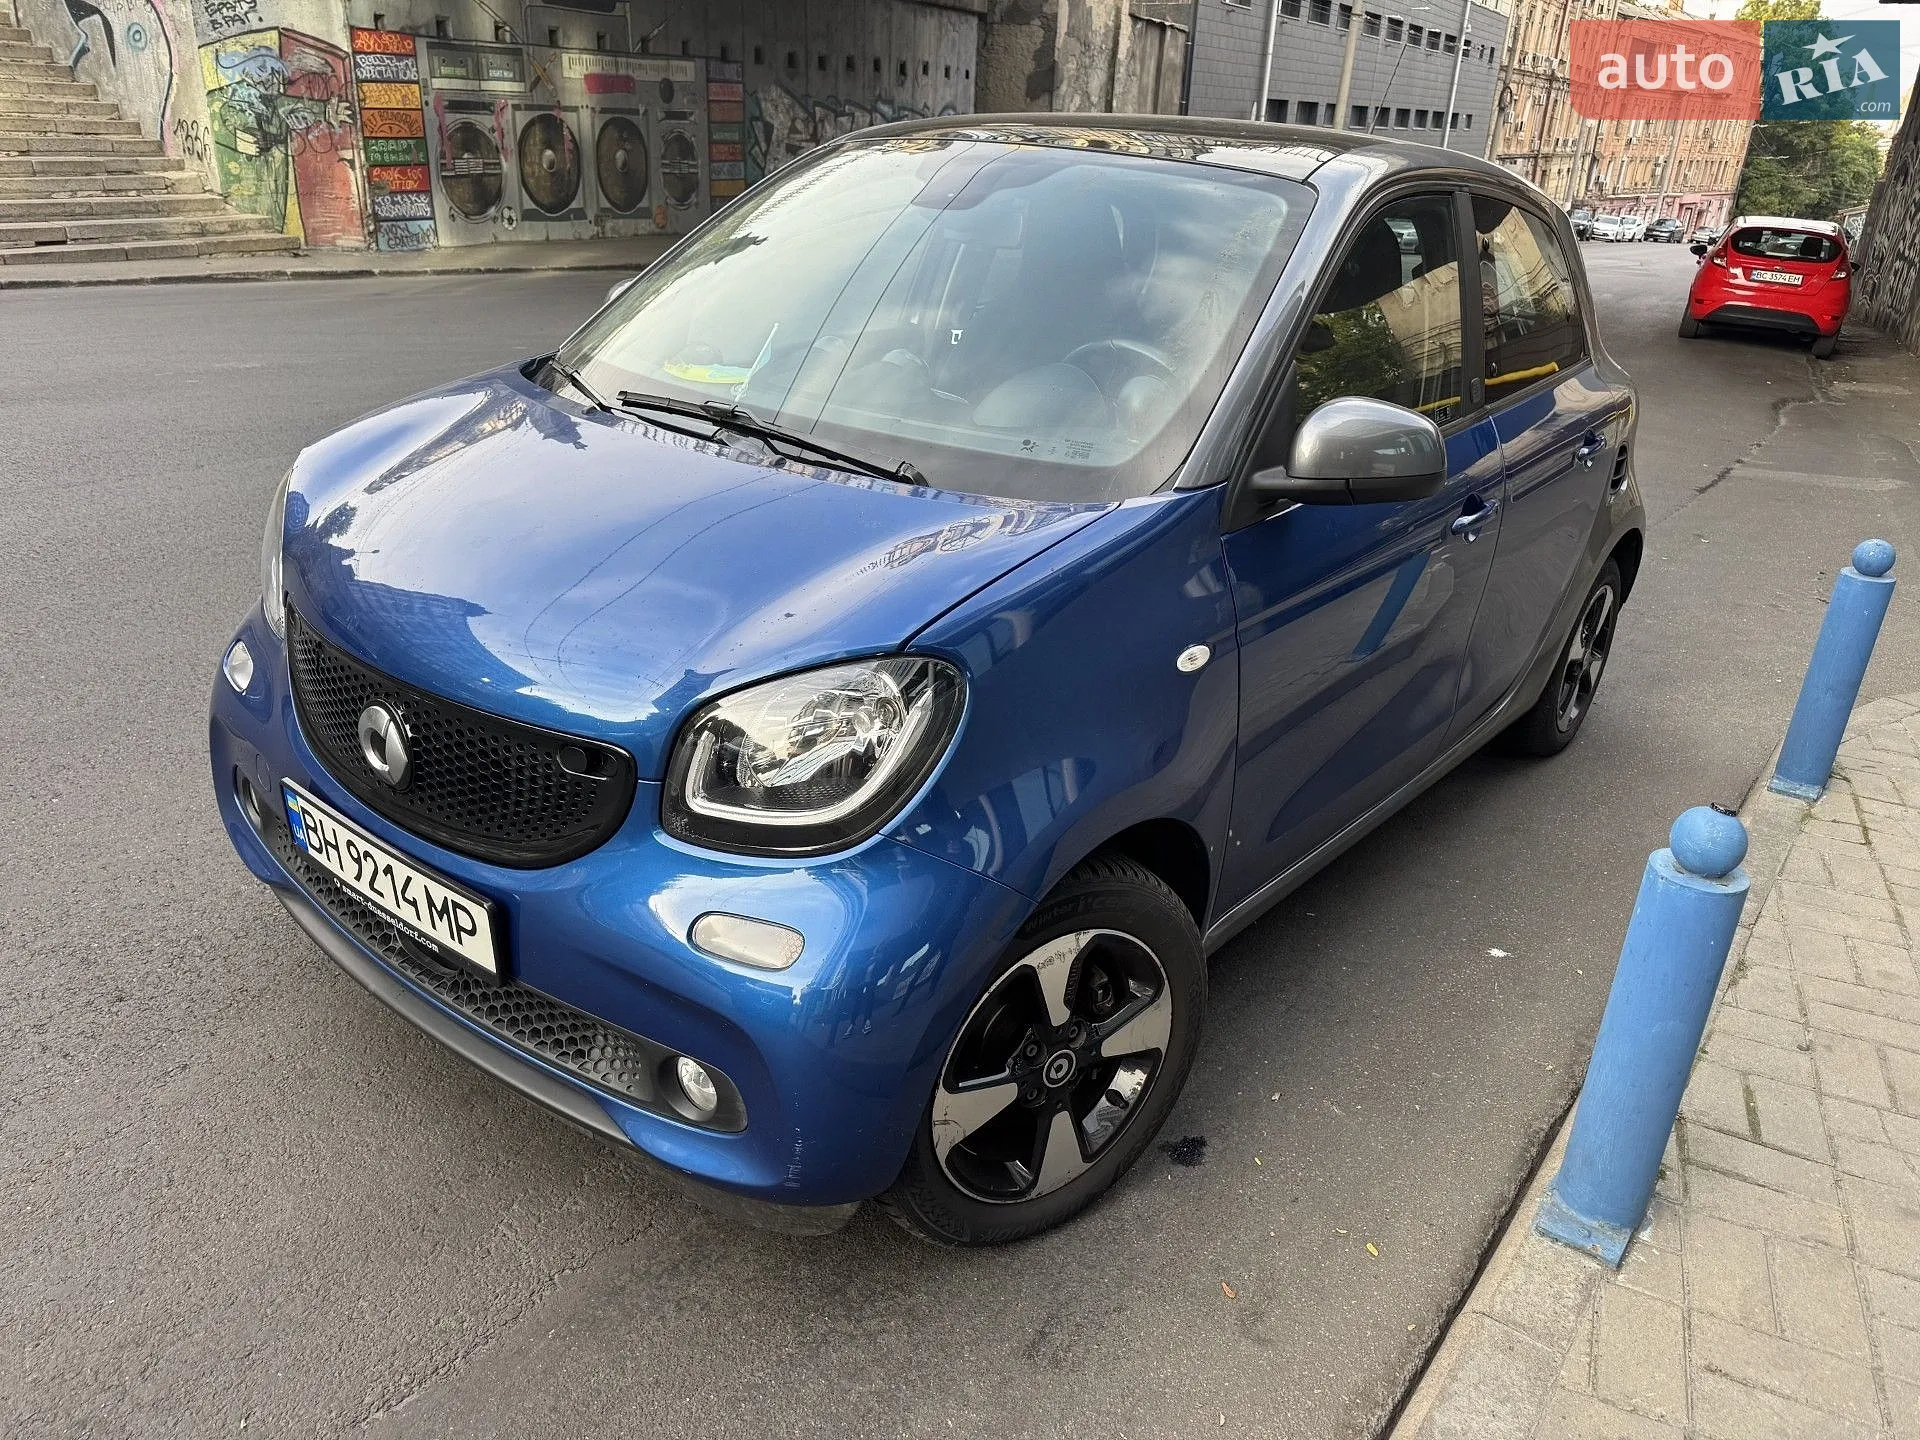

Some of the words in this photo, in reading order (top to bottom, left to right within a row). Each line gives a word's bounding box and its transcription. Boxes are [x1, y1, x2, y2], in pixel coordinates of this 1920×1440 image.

[1769, 272, 1787, 281] 3574
[293, 825, 306, 842] UA
[300, 805, 346, 872] BH
[345, 838, 422, 922] 9214
[424, 884, 478, 948] MP
